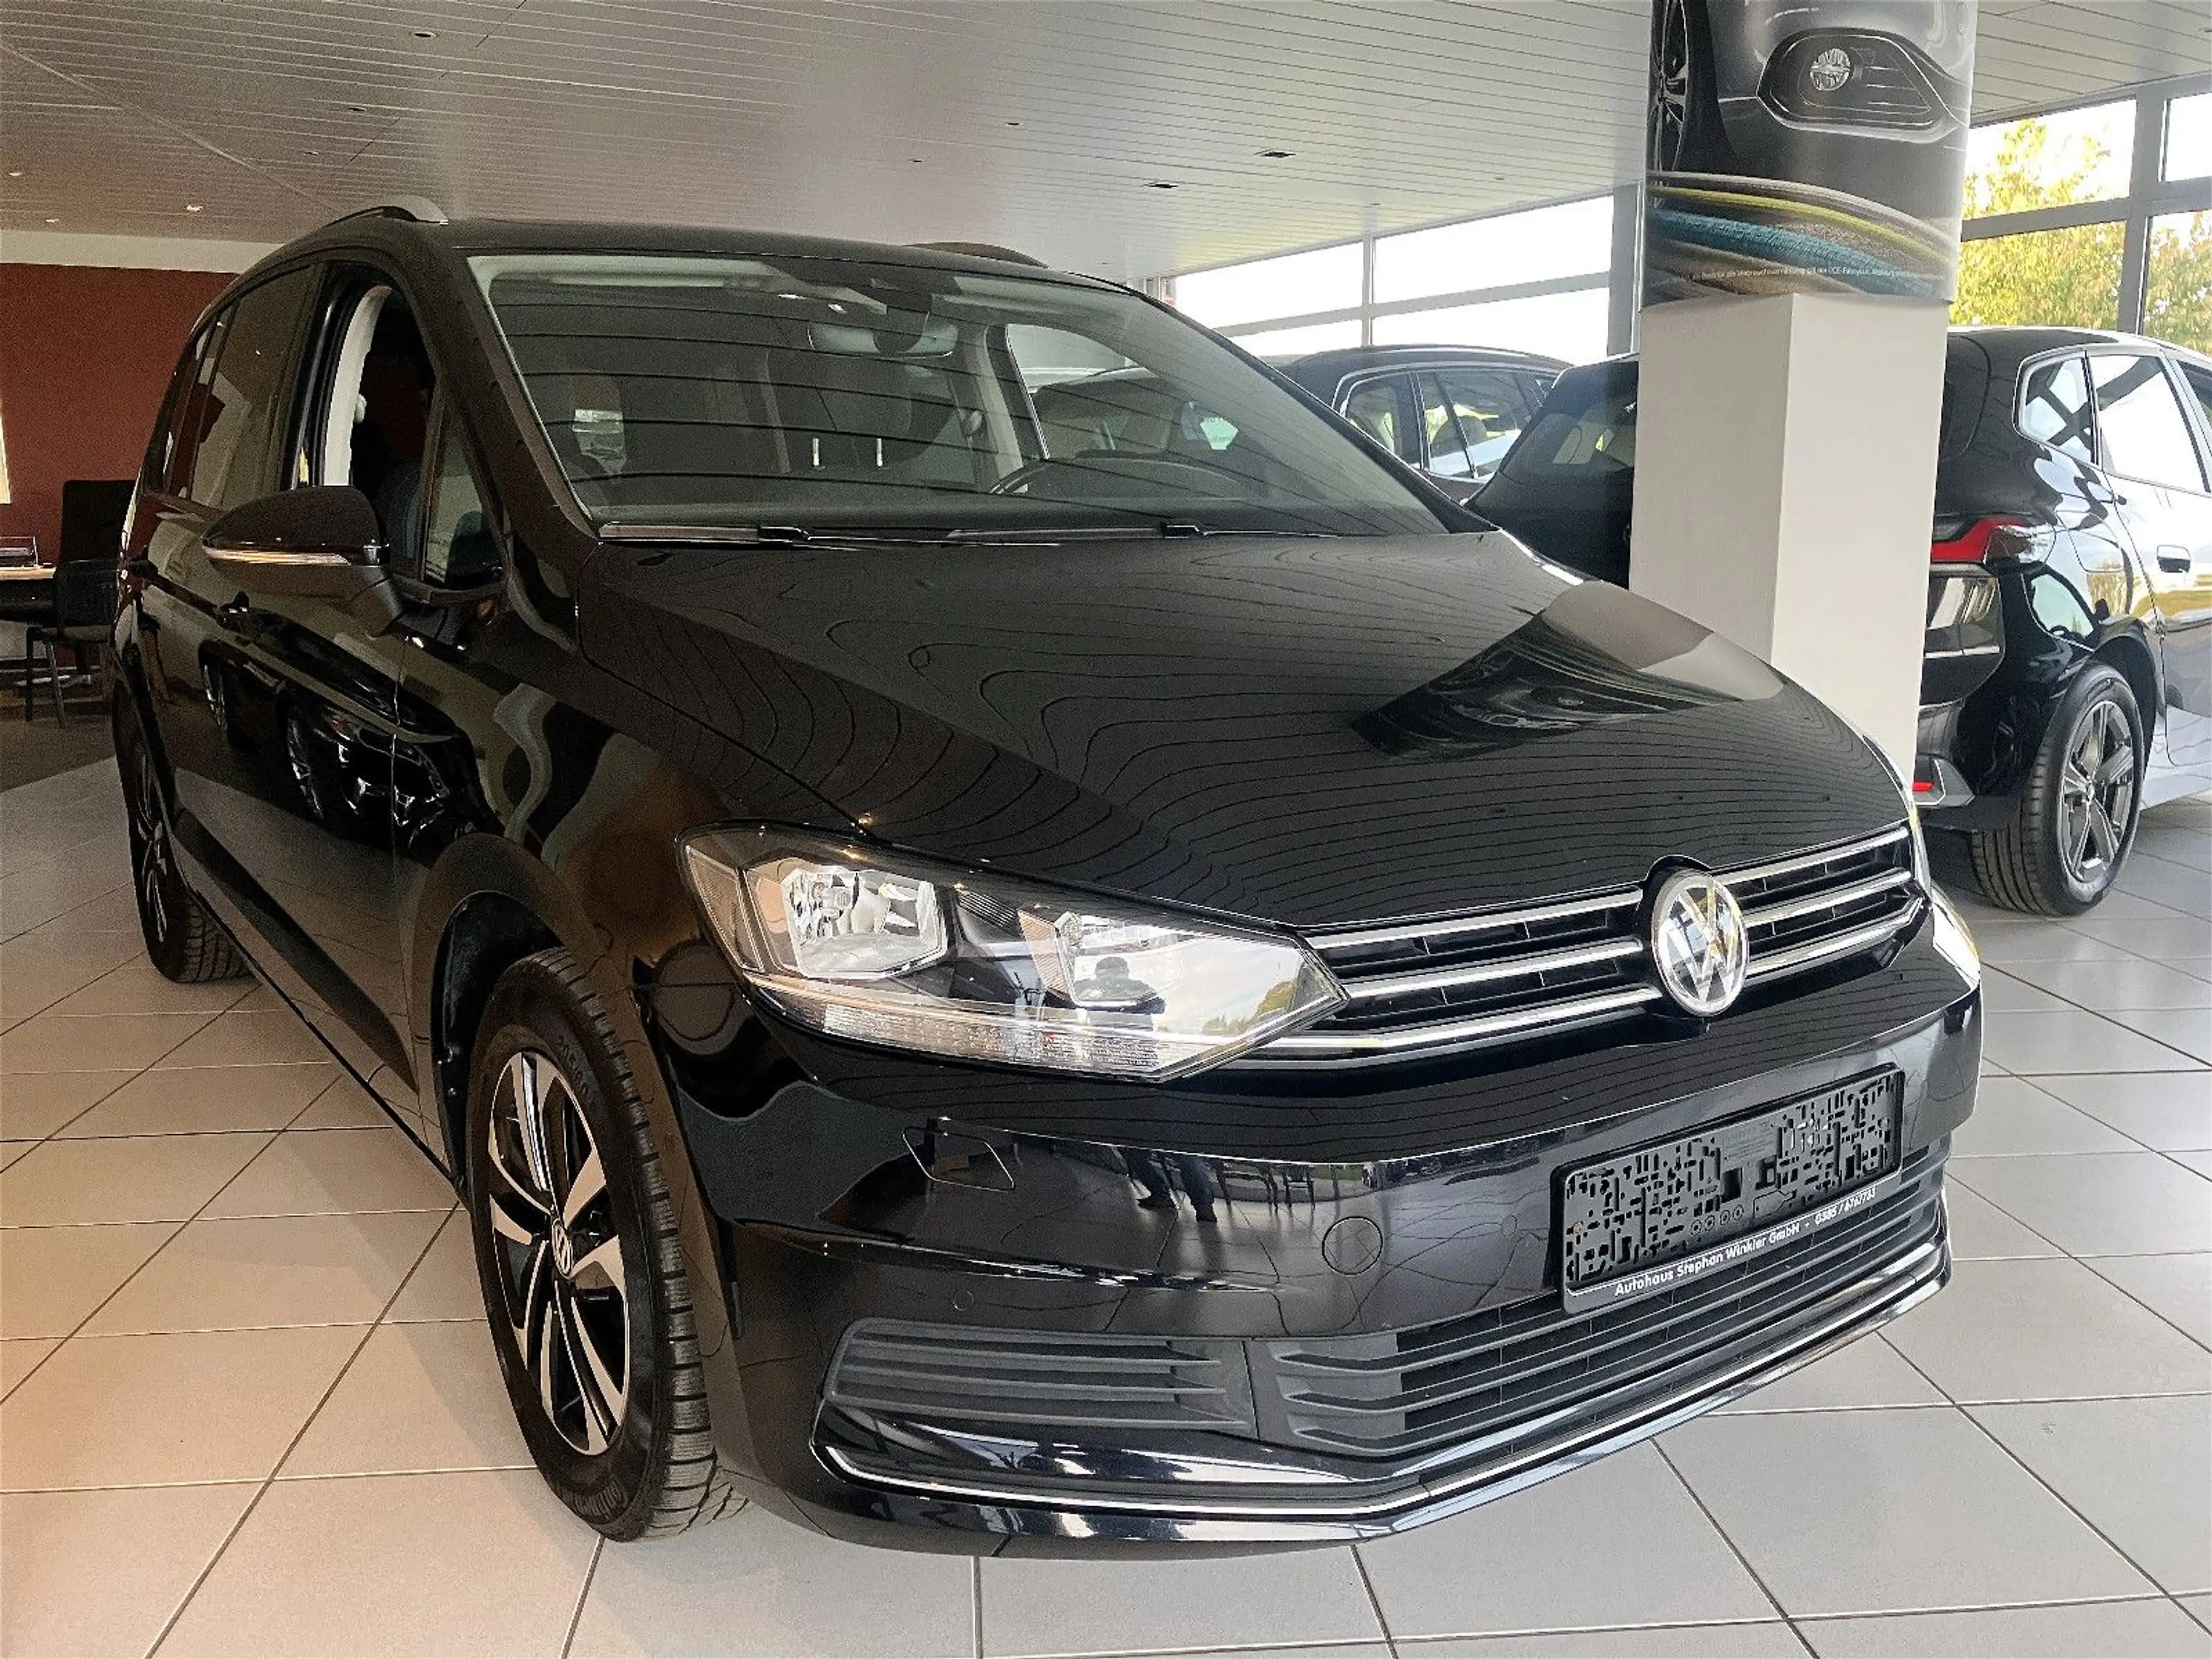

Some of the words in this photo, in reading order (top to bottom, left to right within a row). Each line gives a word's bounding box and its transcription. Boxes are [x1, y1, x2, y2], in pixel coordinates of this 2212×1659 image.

[1615, 1270, 1674, 1296] Autohaus
[1677, 1253, 1724, 1278] Stephan
[1725, 1237, 1767, 1259] Winkler
[1768, 1222, 1800, 1244] GmbH
